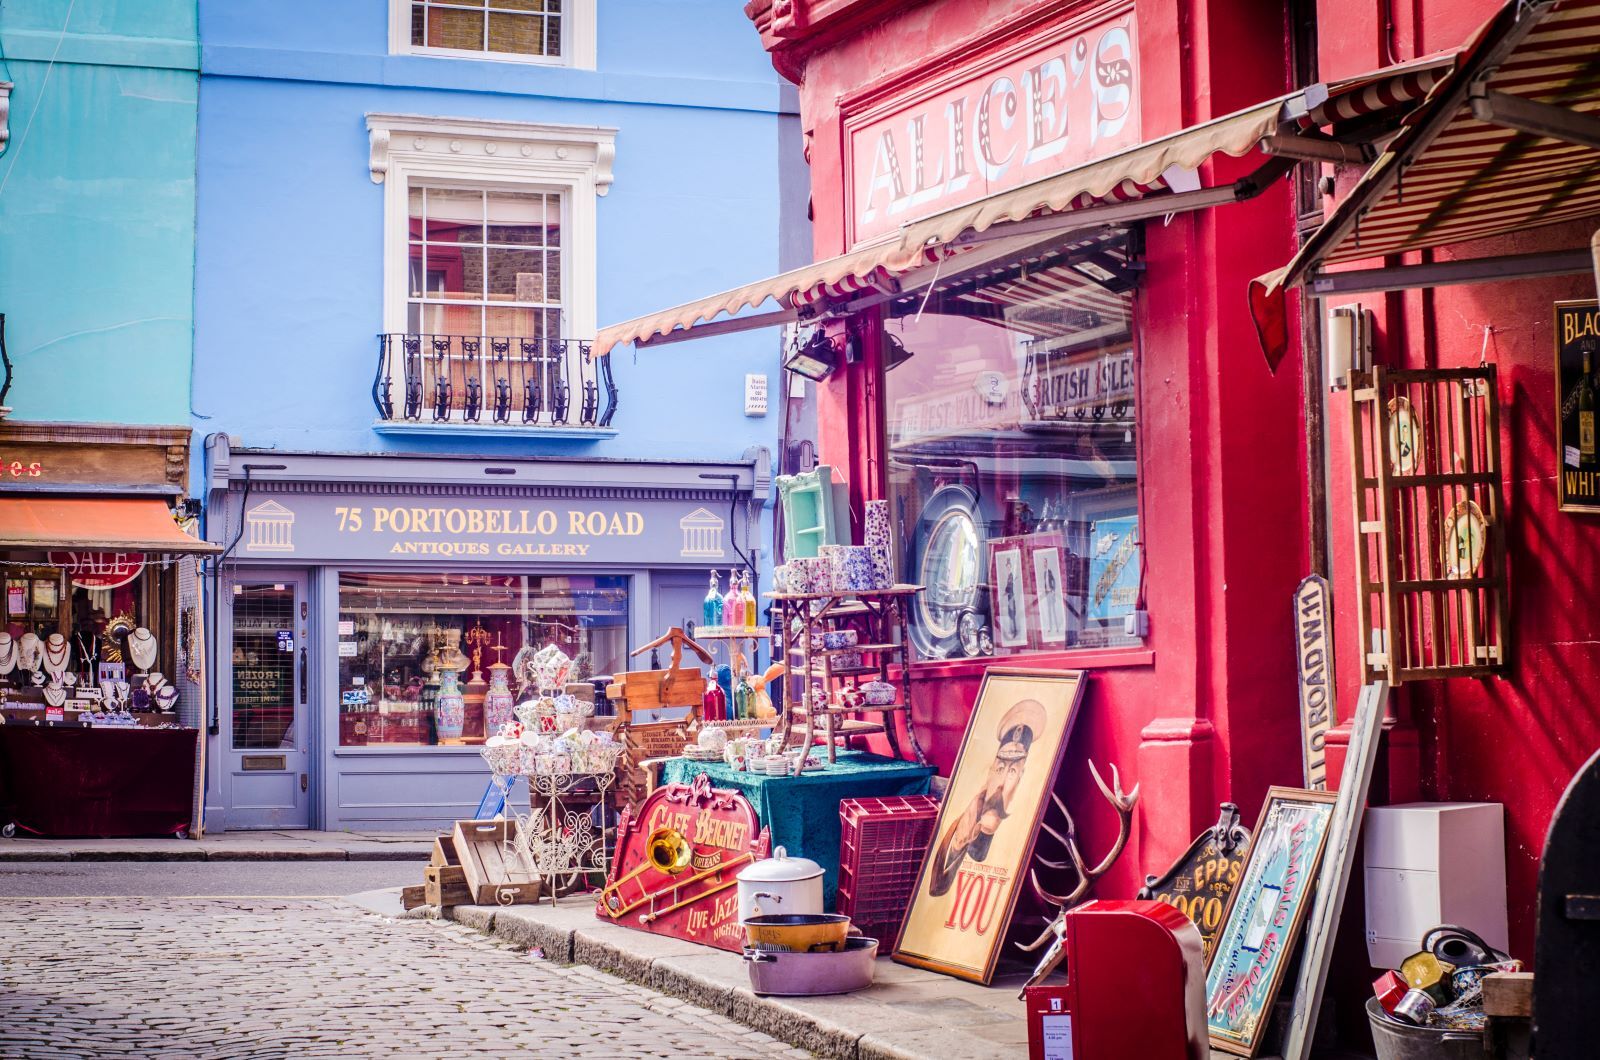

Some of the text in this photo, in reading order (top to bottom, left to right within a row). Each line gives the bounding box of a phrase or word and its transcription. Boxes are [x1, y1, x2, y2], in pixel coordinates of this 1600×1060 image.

[860, 17, 1134, 224] ALICE'S
[0, 457, 42, 477] es
[335, 507, 644, 536] 75 PORTOBELLO ROAD
[69, 552, 130, 575] SALE
[390, 542, 590, 556] ANTIQUES GALLERY
[1301, 589, 1323, 650] W.11
[1305, 648, 1328, 729] ROAD
[693, 808, 748, 851] BEIGNET
[1194, 858, 1241, 892] EPPS
[686, 893, 738, 936] LIVE JAZZ
[944, 870, 1009, 936] YOU
[1054, 1001, 1058, 1009] 1
